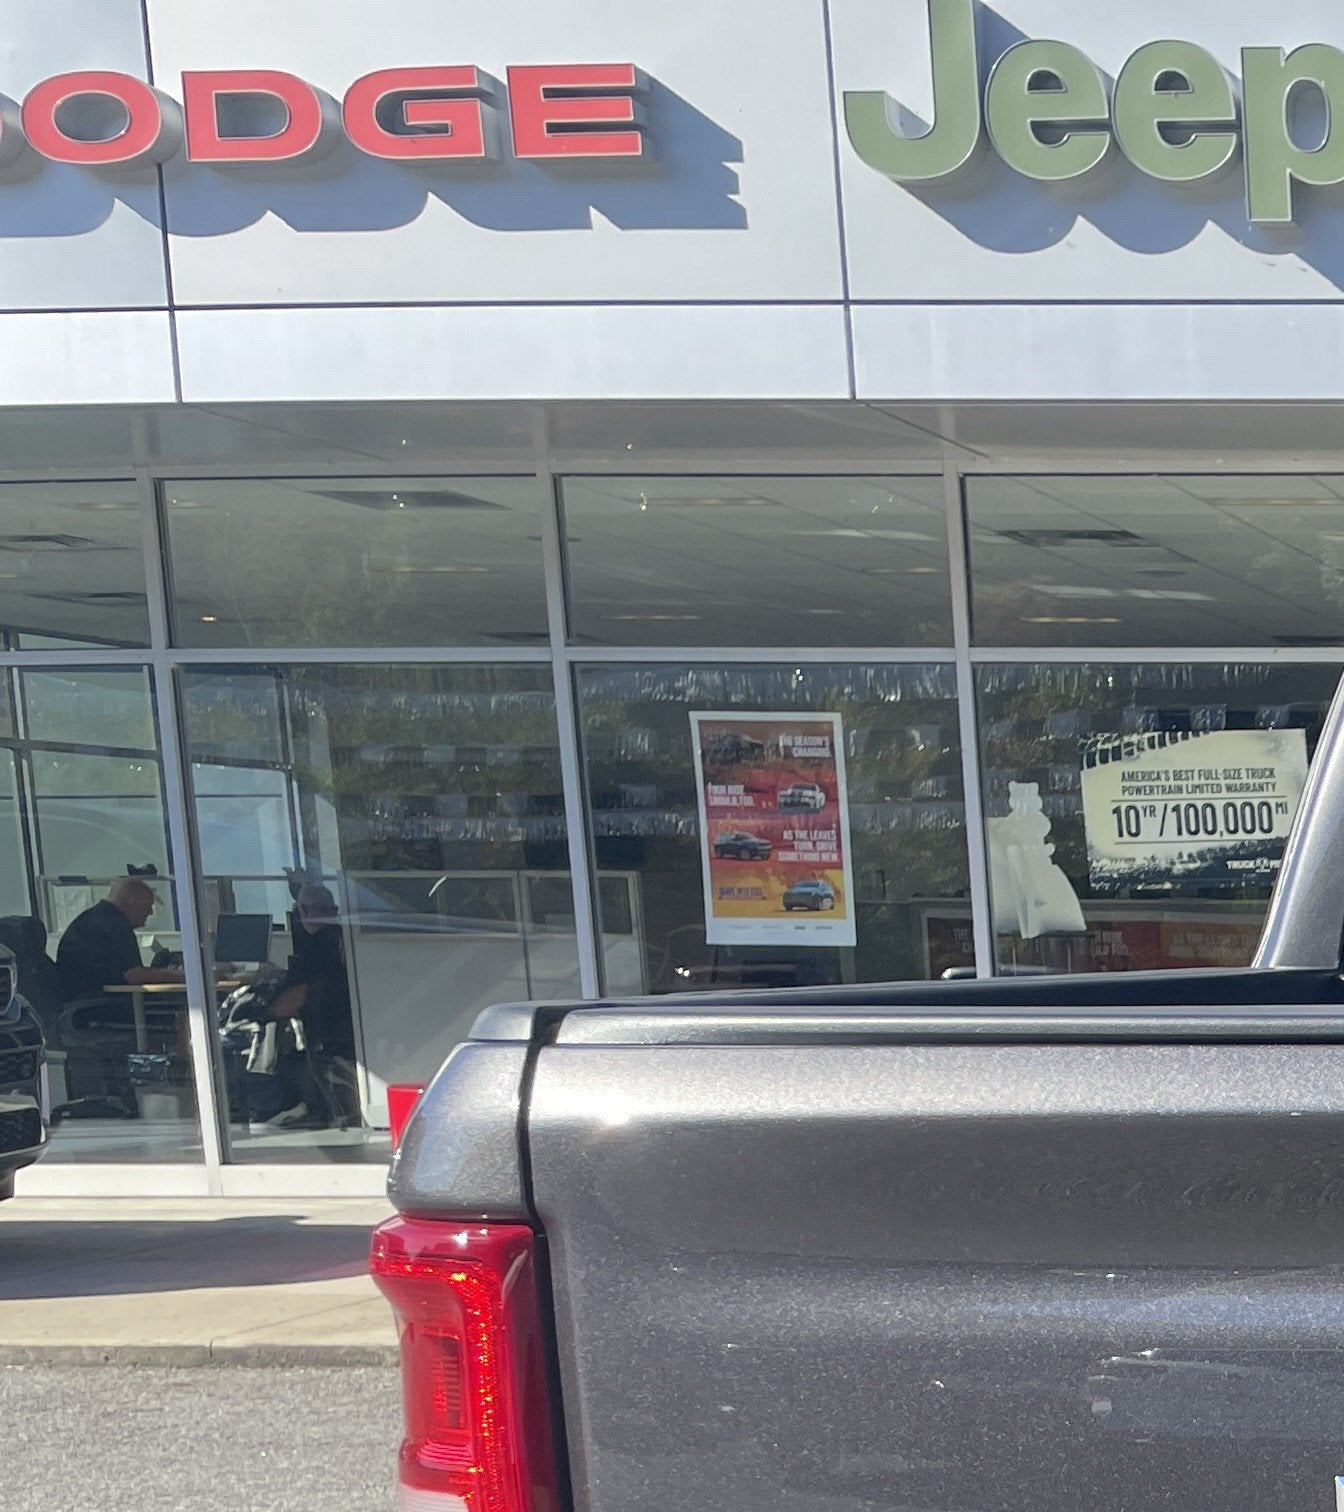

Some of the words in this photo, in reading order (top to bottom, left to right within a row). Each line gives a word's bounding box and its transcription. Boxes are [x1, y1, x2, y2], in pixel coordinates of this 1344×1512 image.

[1121, 769, 1170, 783] AMERICA'S
[1172, 768, 1196, 782] BEST
[1198, 768, 1243, 781] FULL-SIZE
[1245, 767, 1276, 780] TRUCK
[1121, 784, 1184, 796] POWERTRAIN
[1185, 782, 1223, 795] LIMITED
[1225, 781, 1277, 794] WARRANTY
